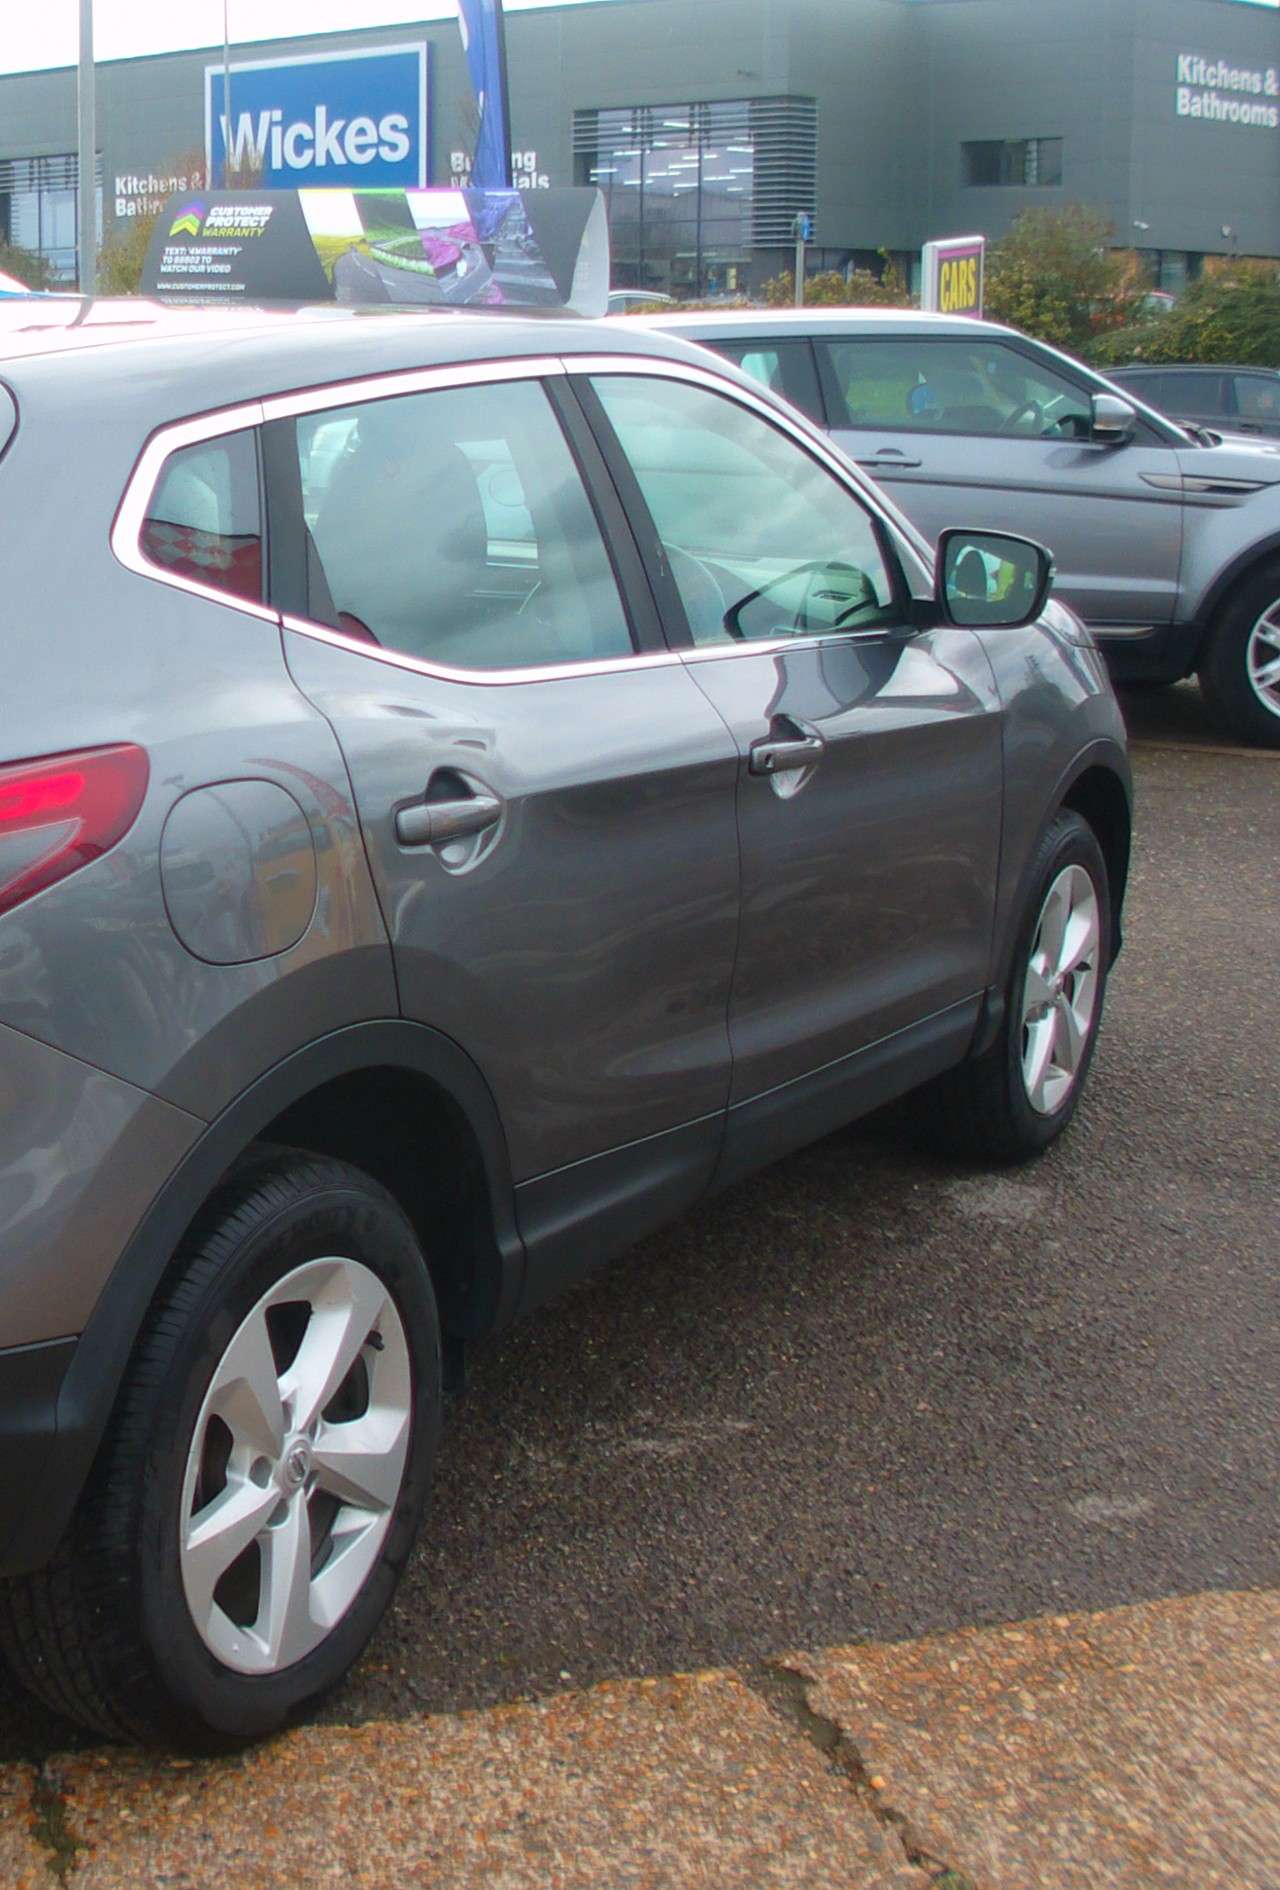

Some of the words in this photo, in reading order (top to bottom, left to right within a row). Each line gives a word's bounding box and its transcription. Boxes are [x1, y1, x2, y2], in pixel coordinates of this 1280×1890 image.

[1177, 53, 1263, 94] Kitchens
[1264, 67, 1279, 96] &
[1176, 86, 1279, 128] Bathrooms
[219, 105, 411, 172] Wickes
[115, 175, 187, 196] Kitchens
[209, 205, 273, 217] CUSTOMER
[205, 216, 269, 227] PROTECT
[202, 227, 265, 238] WARRANTY
[160, 264, 188, 273] WATCH
[189, 264, 206, 273] OUR
[207, 264, 232, 273] VIDEO
[162, 256, 173, 265] TO
[201, 256, 213, 265] TO
[940, 257, 977, 312] CARS
